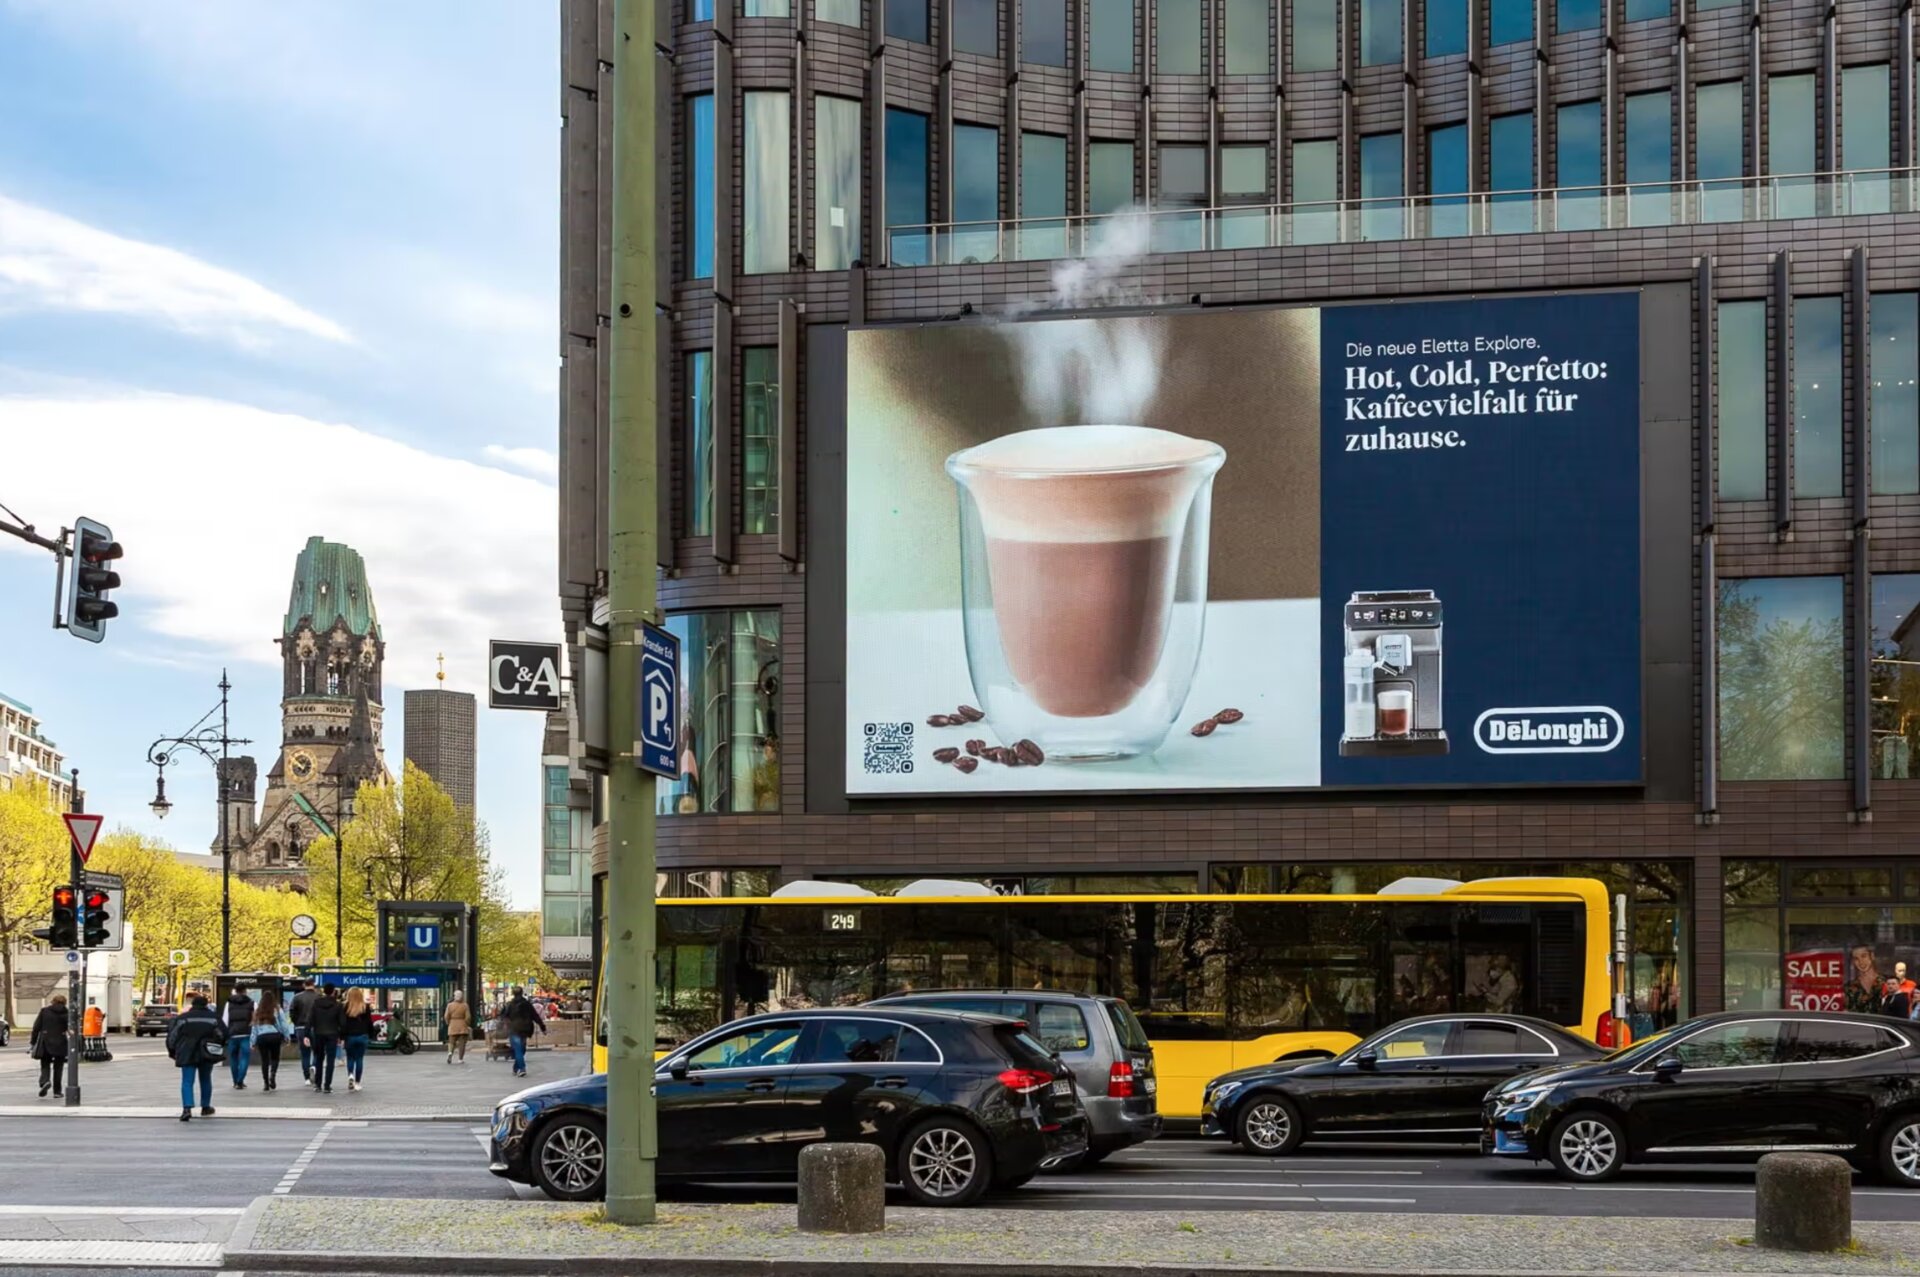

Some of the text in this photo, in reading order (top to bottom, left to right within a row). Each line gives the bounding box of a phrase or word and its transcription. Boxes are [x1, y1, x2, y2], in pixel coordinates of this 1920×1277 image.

[1346, 335, 1540, 357] Die neue Eletta Explore.
[1345, 356, 1607, 391] Hot, Cold, Perfetto:
[1345, 387, 1578, 421] Kaffeevielfalt für
[1345, 426, 1466, 452] zuhause.
[491, 654, 559, 696] C&A
[650, 682, 668, 737] P
[832, 914, 854, 929] 249
[414, 927, 432, 947] U
[343, 976, 417, 985] Kurfürstendamm
[1787, 961, 1840, 978] SALE
[1790, 994, 1841, 1011] 50%
